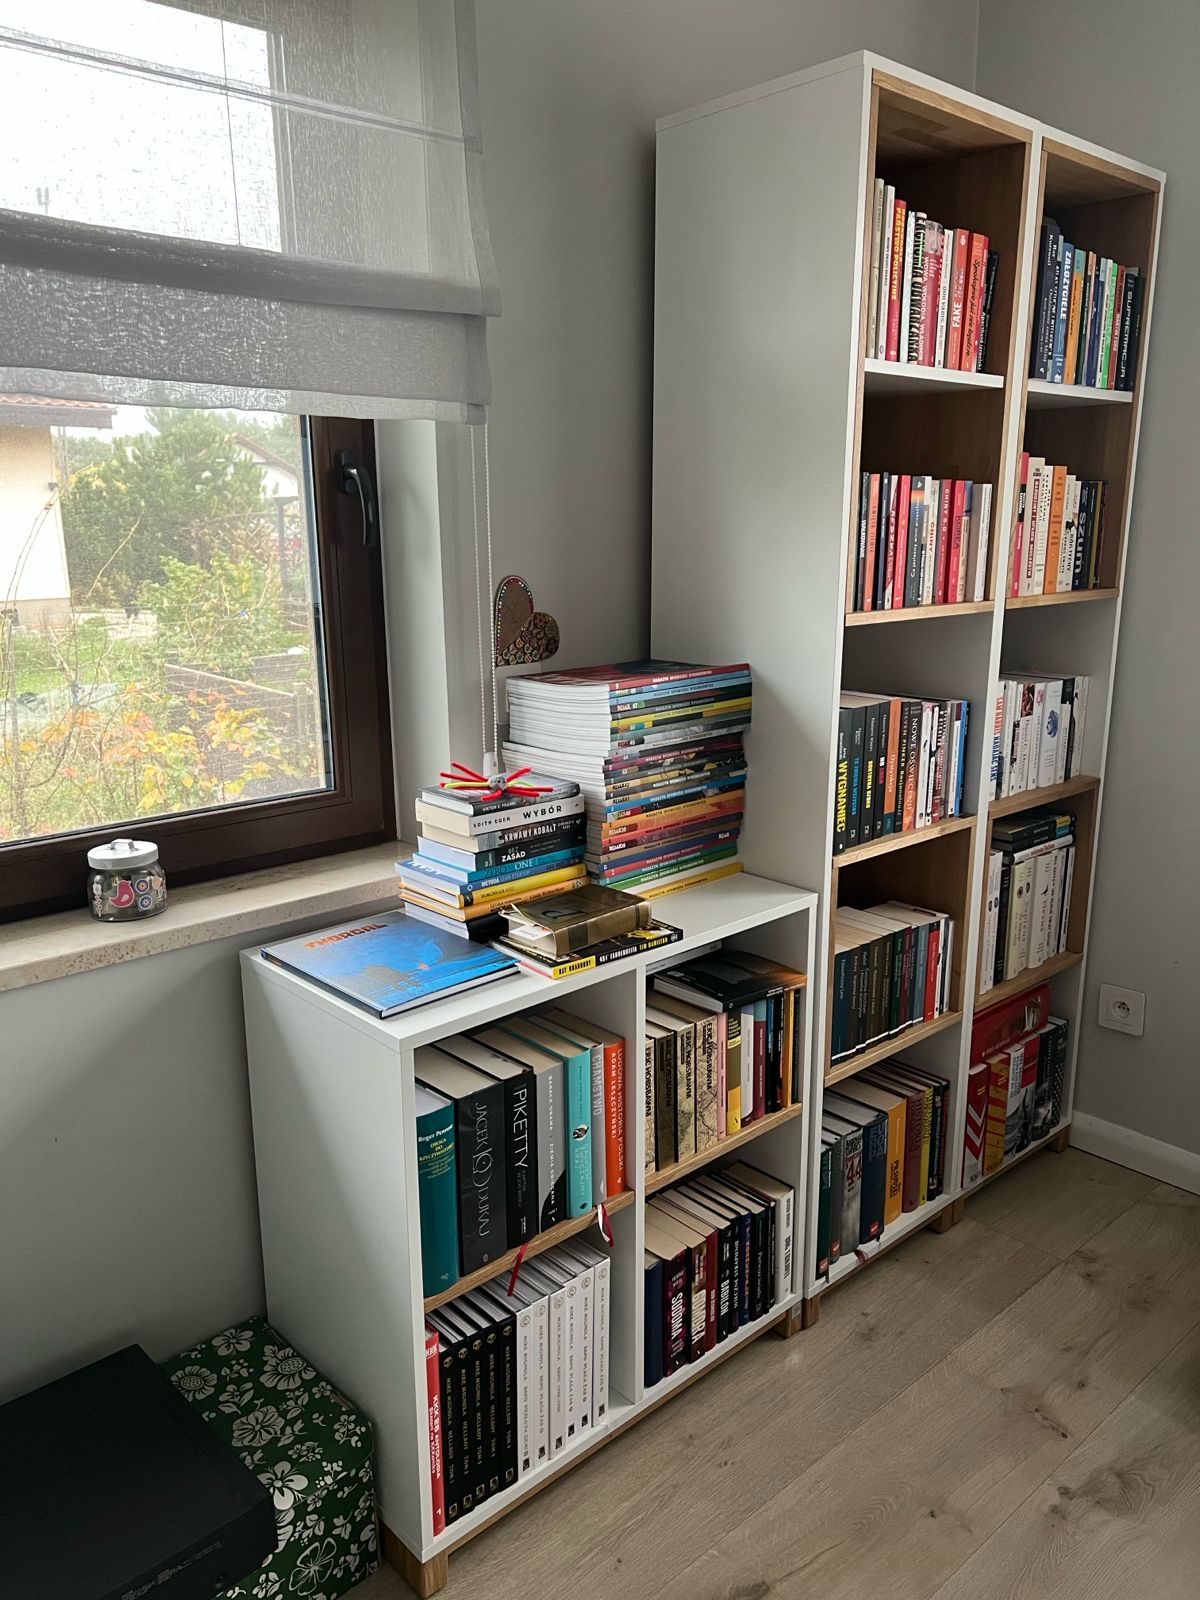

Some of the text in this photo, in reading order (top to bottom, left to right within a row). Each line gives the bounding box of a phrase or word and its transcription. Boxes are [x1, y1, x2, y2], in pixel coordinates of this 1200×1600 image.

[891, 207, 902, 300] PAŃSTWO POLICYJNE
[970, 260, 980, 299] Spokojnie
[1060, 251, 1072, 320] ZAŁOŻYCIELE
[952, 302, 962, 328] FAKE
[1120, 291, 1133, 378] SUPREMACJA
[880, 757, 884, 766] NO
[906, 718, 918, 812] NOWE OŚWIECENIE
[990, 766, 998, 781] SENS
[837, 761, 848, 832] WYGNANIEC
[523, 806, 562, 819] WYBÓR
[505, 824, 556, 842] KRWAWY KOBAŁT
[485, 859, 533, 877] ZERO ONE
[502, 851, 525, 862] ZASAD
[481, 878, 499, 887] METODA
[304, 923, 388, 949] THORGAL
[639, 941, 647, 950] TIM
[648, 936, 668, 948] HAMILTON
[559, 959, 591, 974] RAY BRADBURY
[592, 1055, 602, 1115] CHAMSTWO
[418, 1134, 435, 1142] Roger
[513, 1089, 528, 1167] PIKETTY
[475, 1102, 490, 1236] JACEK DUKAJ
[720, 1280, 730, 1316] BABILON
[671, 1292, 683, 1340] SODOMA
[692, 1289, 706, 1344] GOMORA
